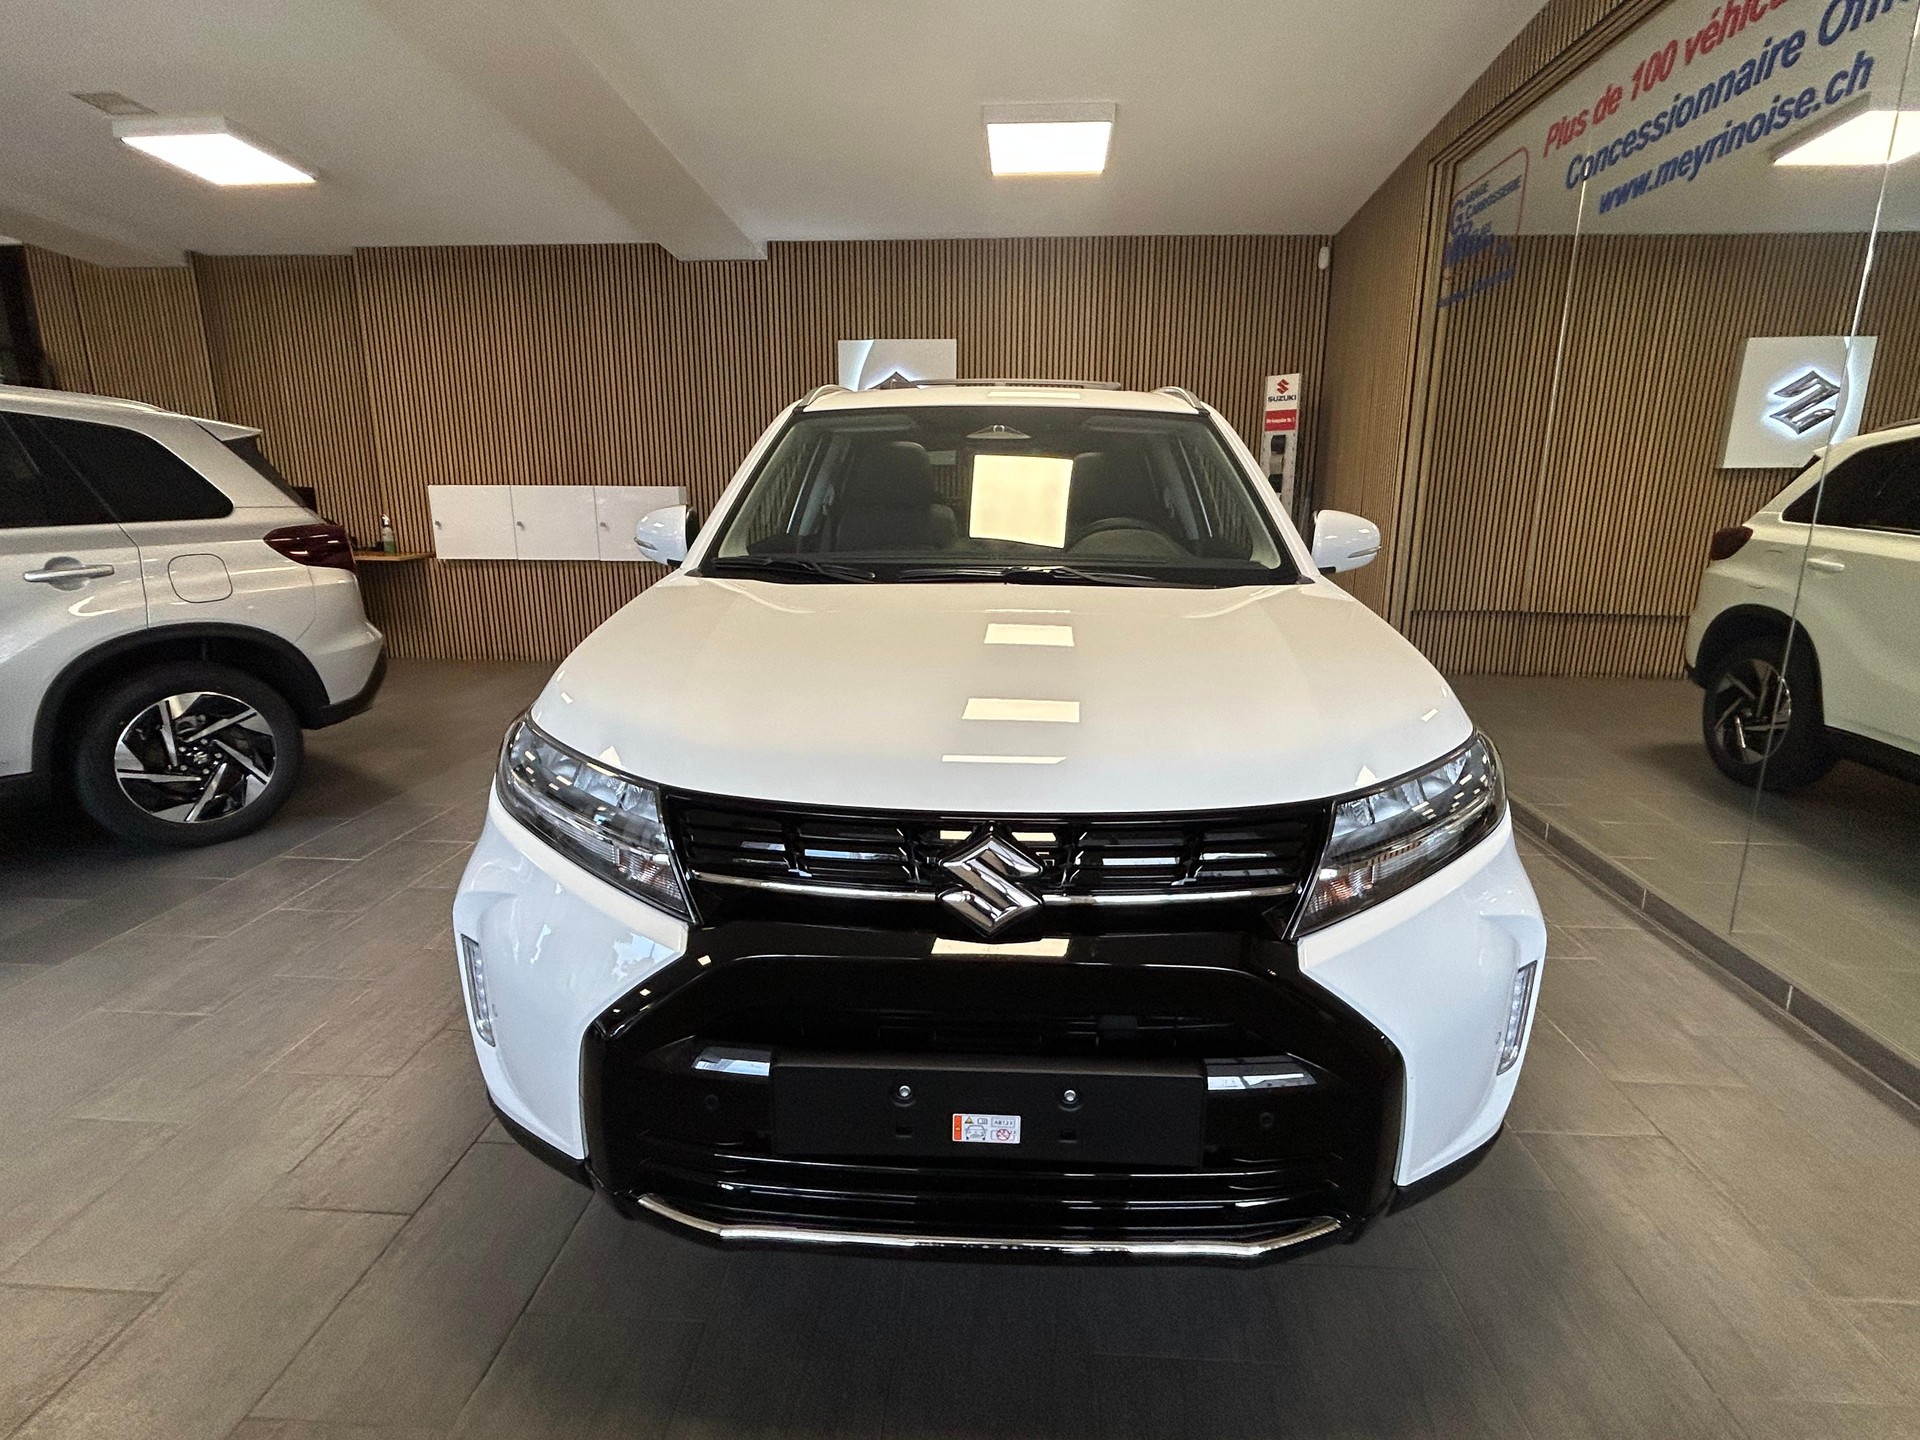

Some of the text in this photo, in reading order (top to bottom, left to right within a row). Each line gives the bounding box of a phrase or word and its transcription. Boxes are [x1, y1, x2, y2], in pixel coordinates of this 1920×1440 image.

[1543, 108, 1590, 159] Plus
[1592, 83, 1624, 126] de
[1631, 39, 1679, 102] 100
[1565, 29, 1806, 190] Concessionnaire
[1598, 50, 1875, 215] www.meyrinoise.ch
[1267, 394, 1297, 402] SUZUKI
